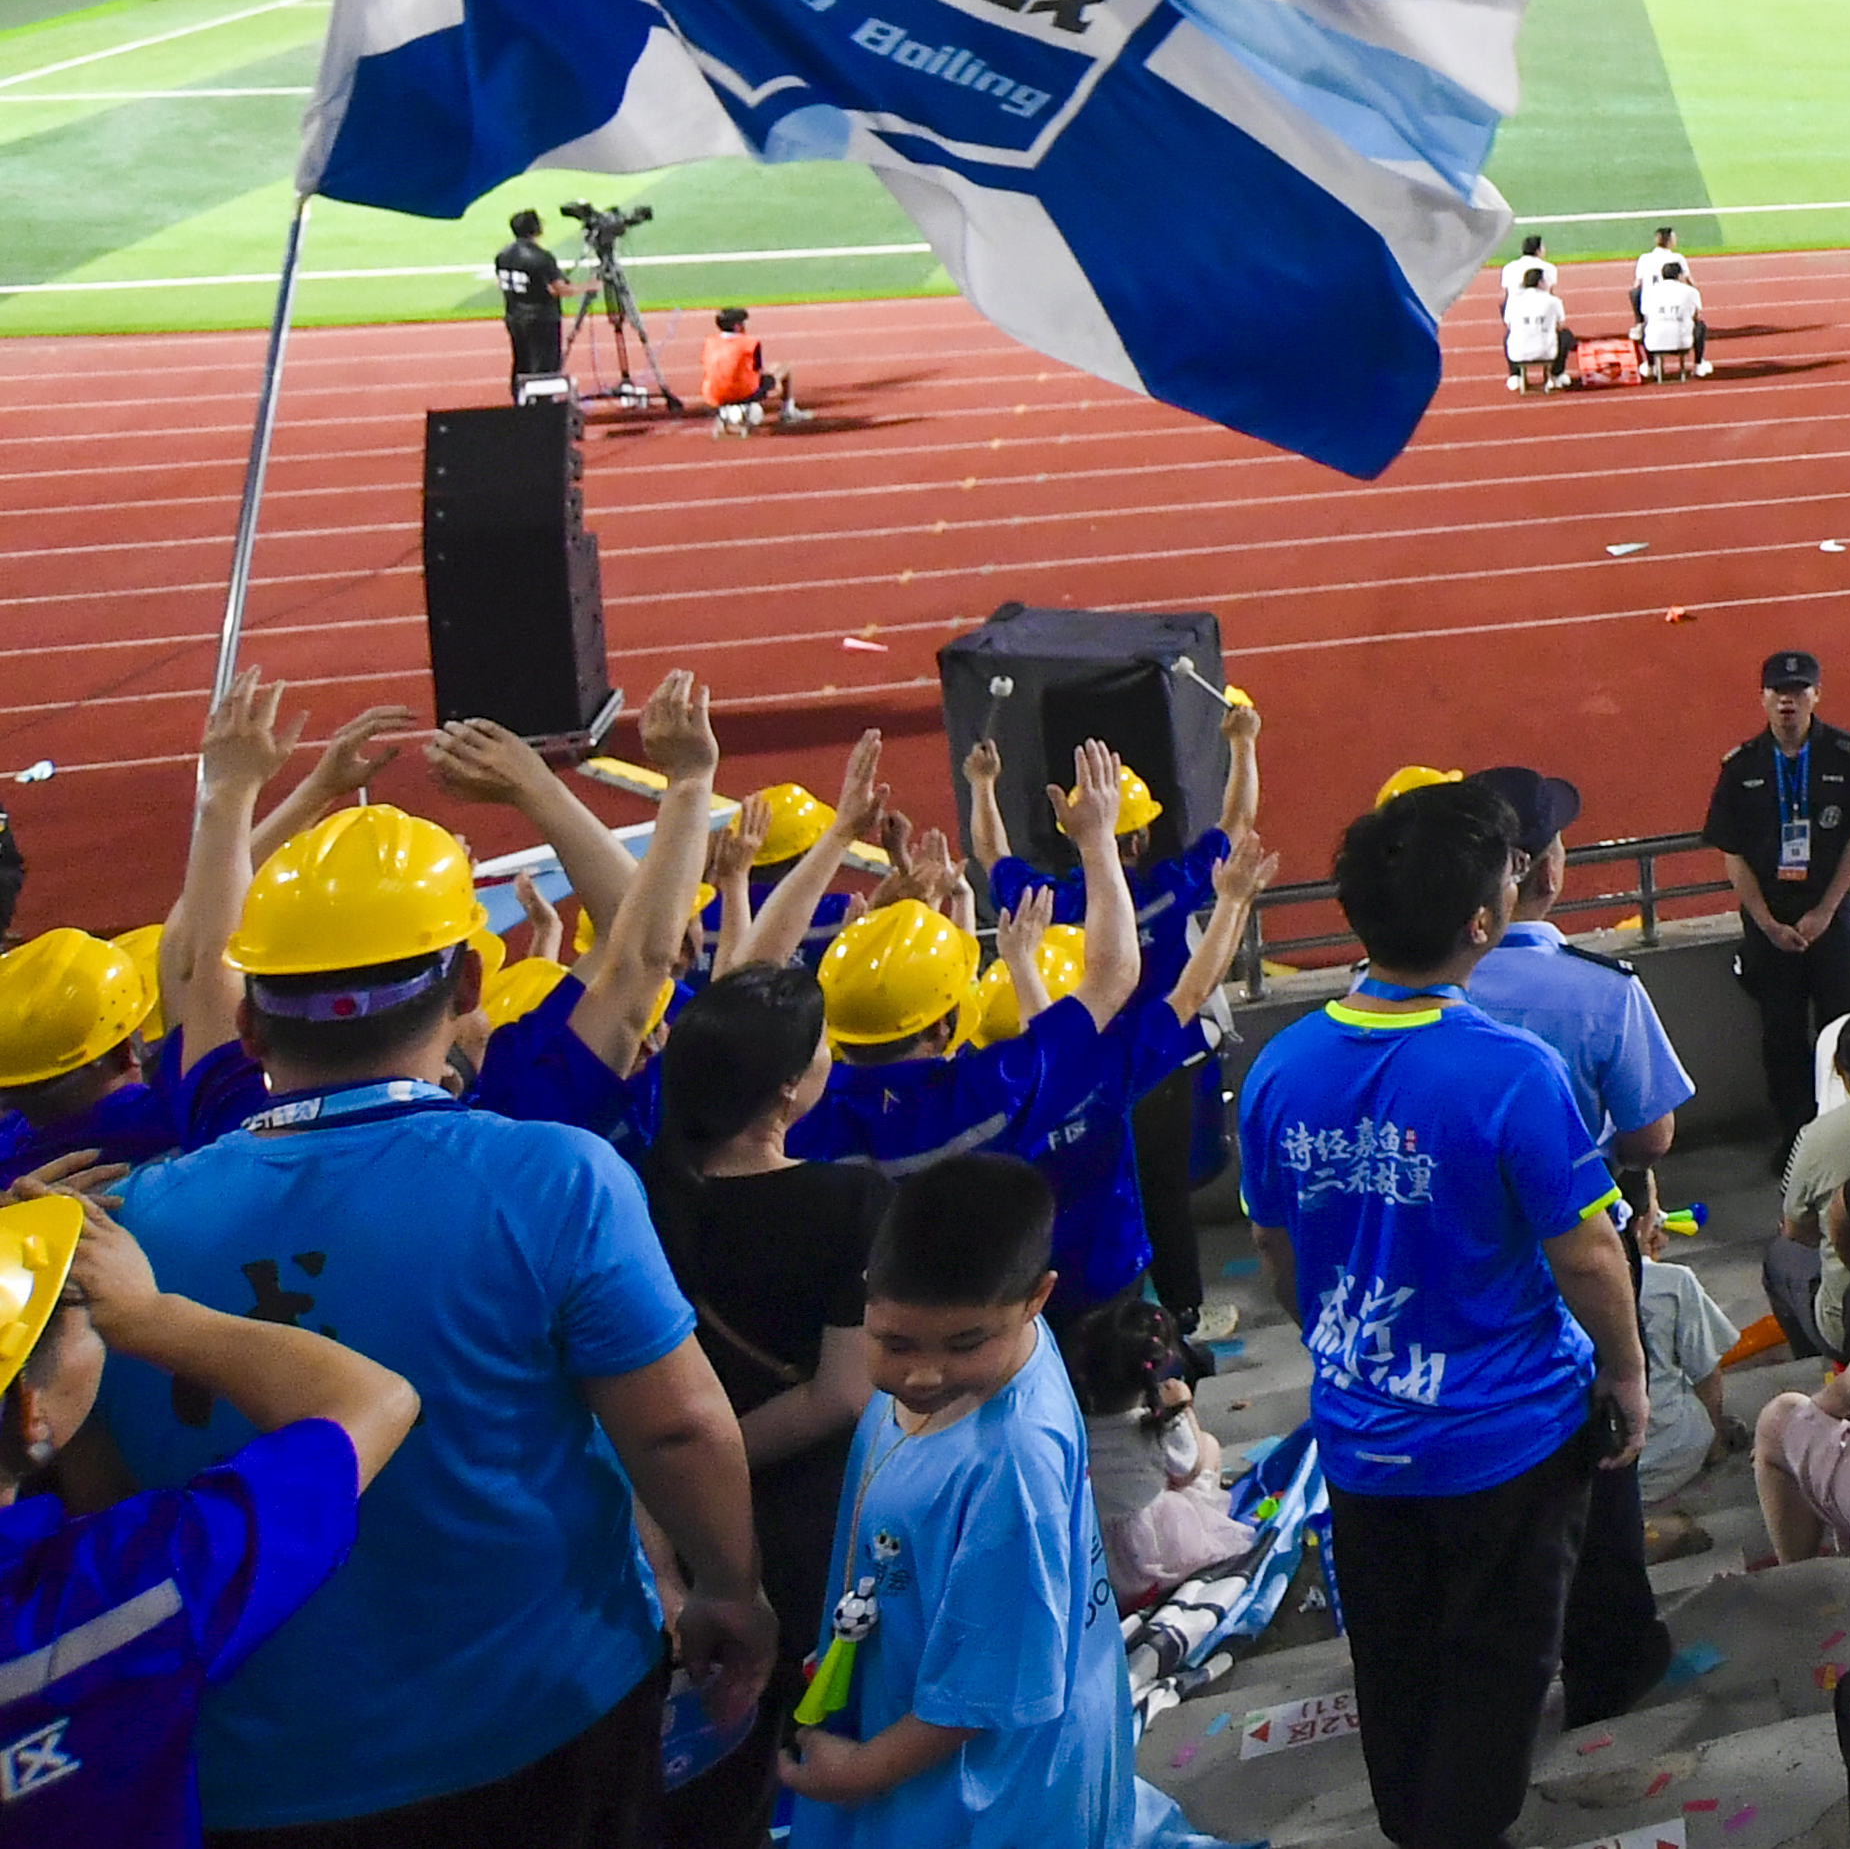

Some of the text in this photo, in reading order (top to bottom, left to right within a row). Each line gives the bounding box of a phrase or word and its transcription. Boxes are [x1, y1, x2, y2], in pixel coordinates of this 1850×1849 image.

[850, 15, 1054, 118] Boiling
[1281, 1116, 1401, 1171] 诗经嘉鱼
